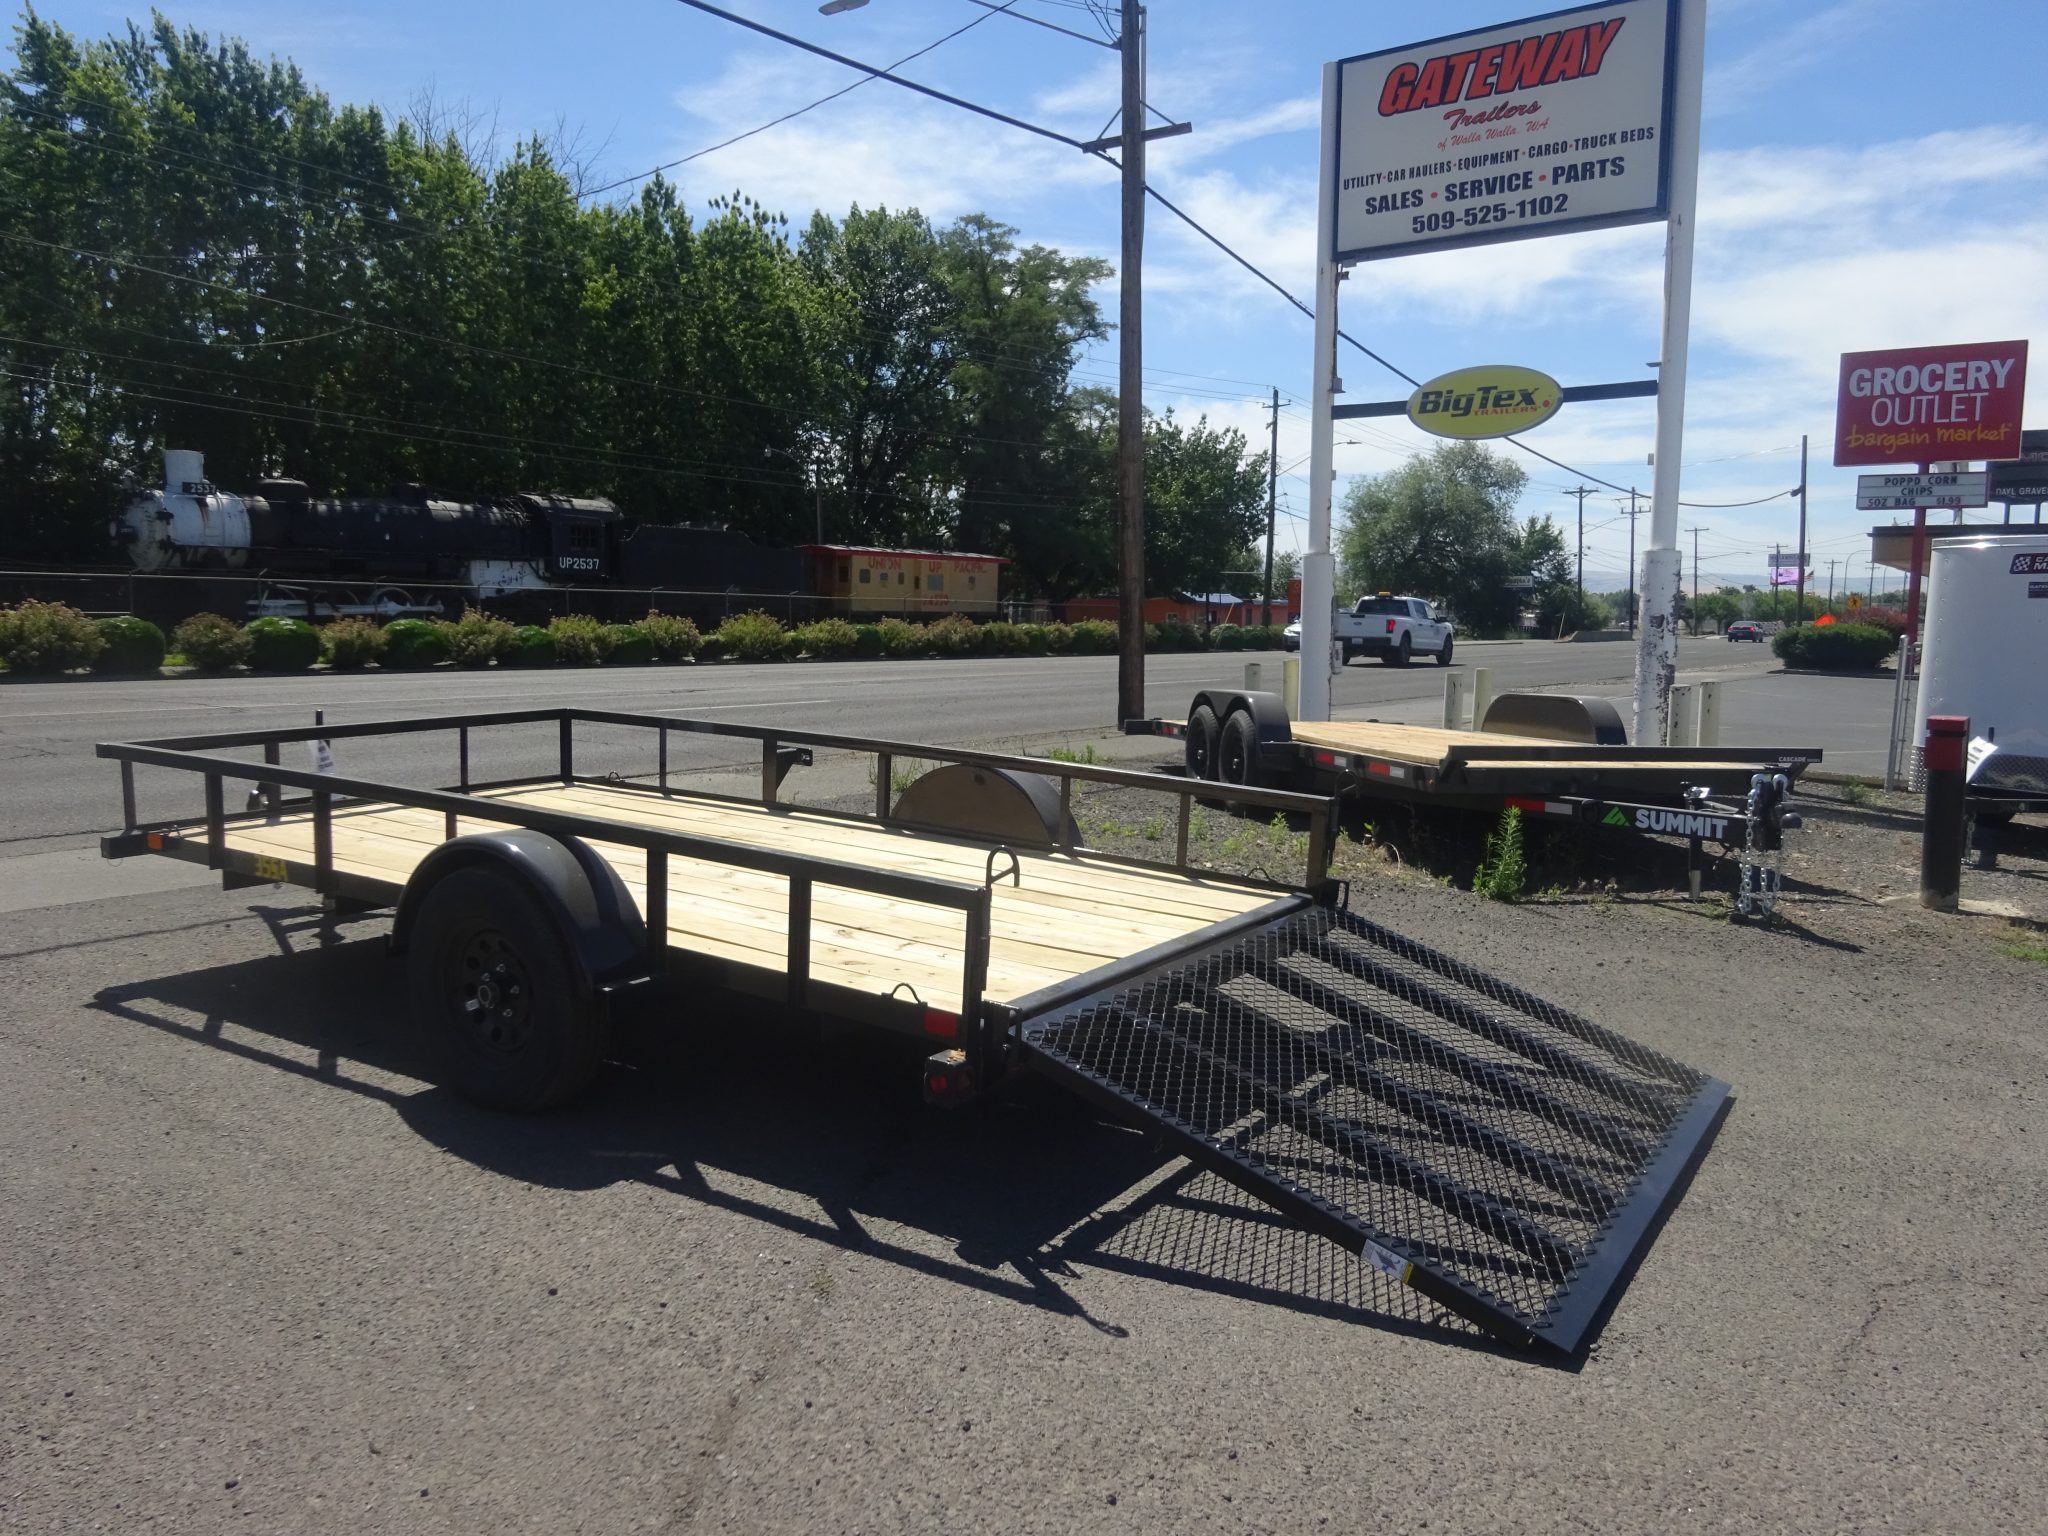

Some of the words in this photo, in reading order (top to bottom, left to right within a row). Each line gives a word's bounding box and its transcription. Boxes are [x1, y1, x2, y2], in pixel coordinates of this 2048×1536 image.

[1378, 16, 1627, 118] GATEWAY
[1442, 100, 1542, 131] Trailers
[1437, 138, 1450, 152] of
[1450, 132, 1481, 147] Walla
[1525, 117, 1550, 133] WA
[1343, 173, 1383, 191] UTILITY
[1387, 169, 1406, 183] CAR
[1409, 161, 1453, 179] HAULERS
[1457, 148, 1520, 172] EQUIPMENT
[1528, 140, 1569, 158] CARGO
[1573, 131, 1617, 151] TRUCK
[1620, 126, 1655, 145] BEDS
[1365, 188, 1424, 216] SALES
[1444, 171, 1534, 203] SERVICE
[1551, 156, 1626, 186] PARTS
[1412, 193, 1569, 234] 509-525-1102
[1849, 358, 2015, 398] GROCERY
[1474, 406, 1538, 417] TRAILERS
[1871, 392, 1989, 427] OUTLET
[1844, 424, 1929, 454] bargain
[1936, 422, 2011, 443] market
[190, 483, 217, 494] 2537
[1884, 476, 1921, 486] POPPD
[1928, 475, 1958, 485] CORN
[1901, 486, 1933, 496] CHIPS
[2018, 486, 2048, 495] GRAVE
[559, 556, 600, 571] UP2537
[868, 556, 902, 571] UNION
[928, 561, 943, 573] UP
[1634, 808, 1728, 839] SUMMIT
